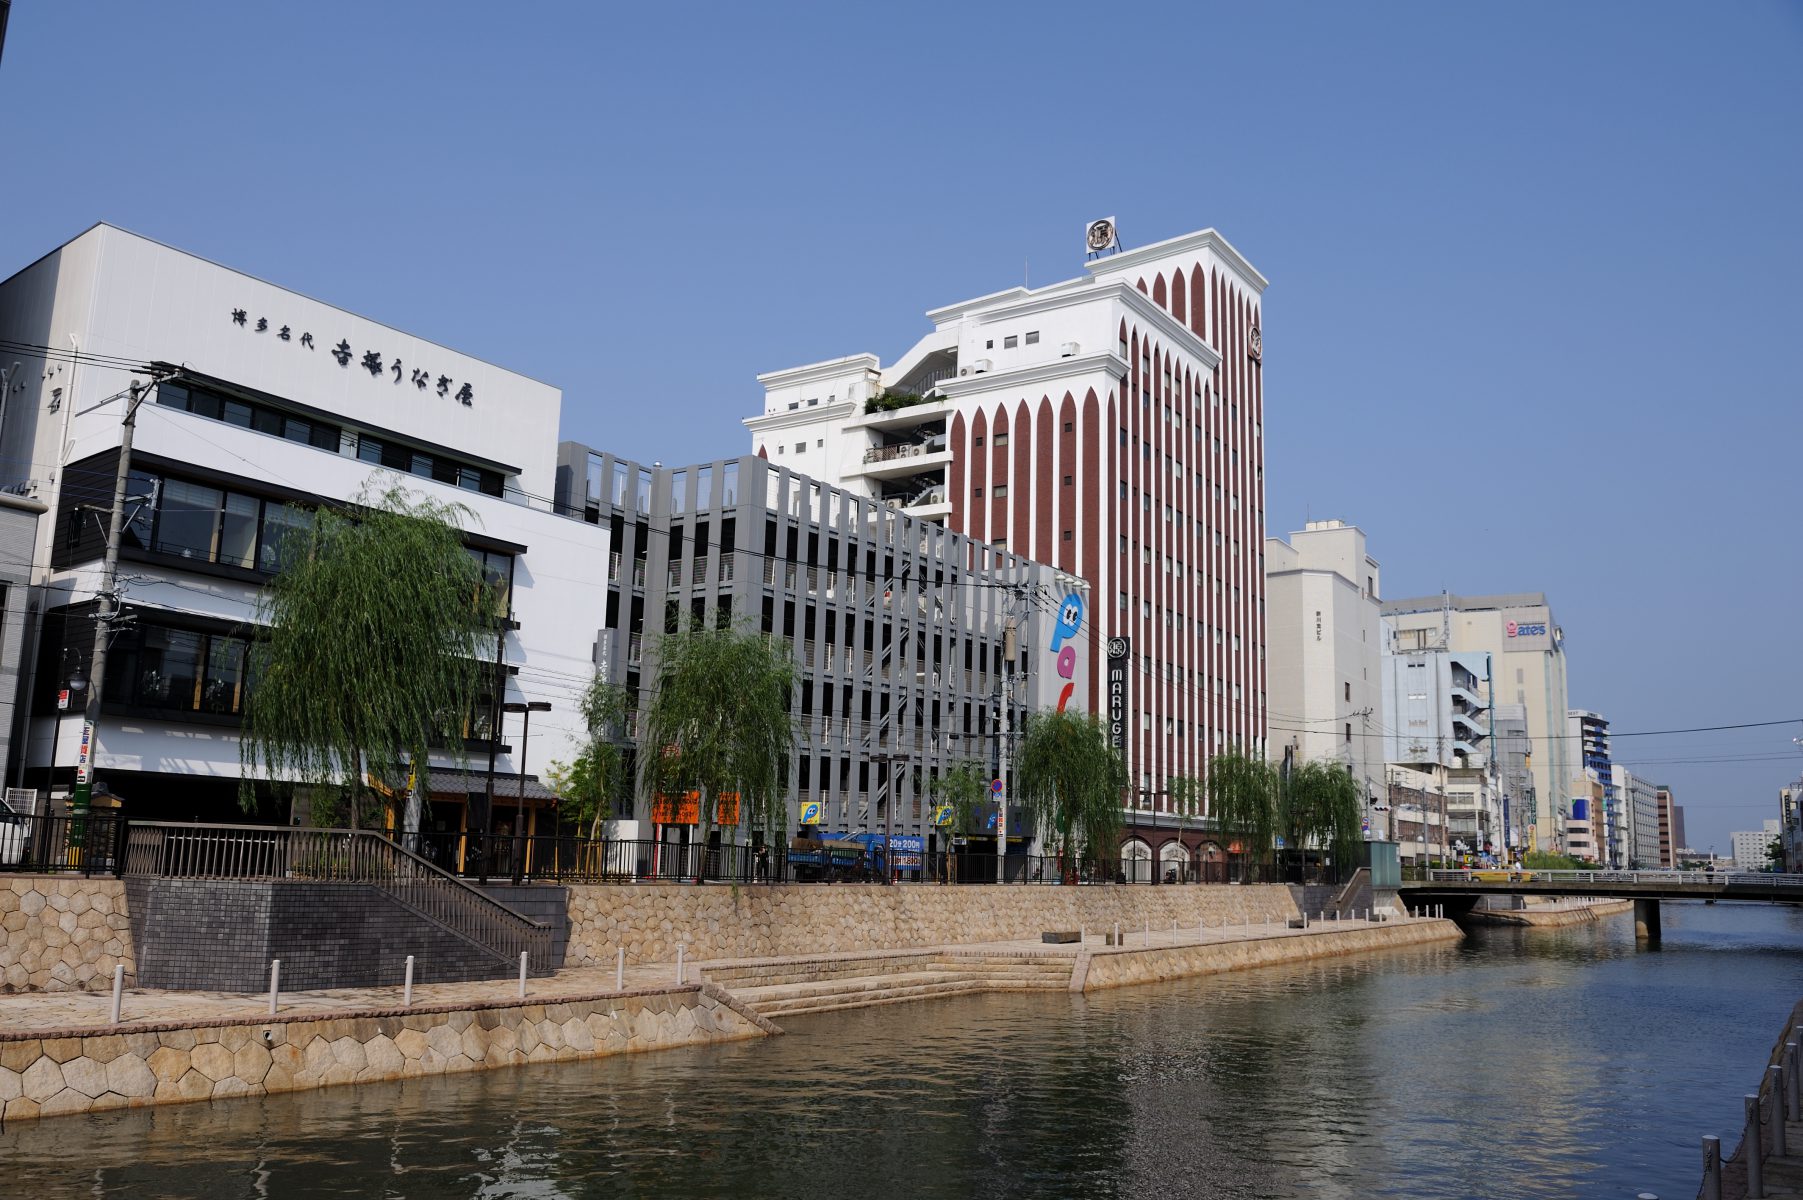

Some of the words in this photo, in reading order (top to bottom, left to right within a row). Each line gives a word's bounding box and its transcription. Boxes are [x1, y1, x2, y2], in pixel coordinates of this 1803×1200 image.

[232, 308, 314, 350] 博多名代
[331, 338, 473, 407] 吉塚うなぎ屋
